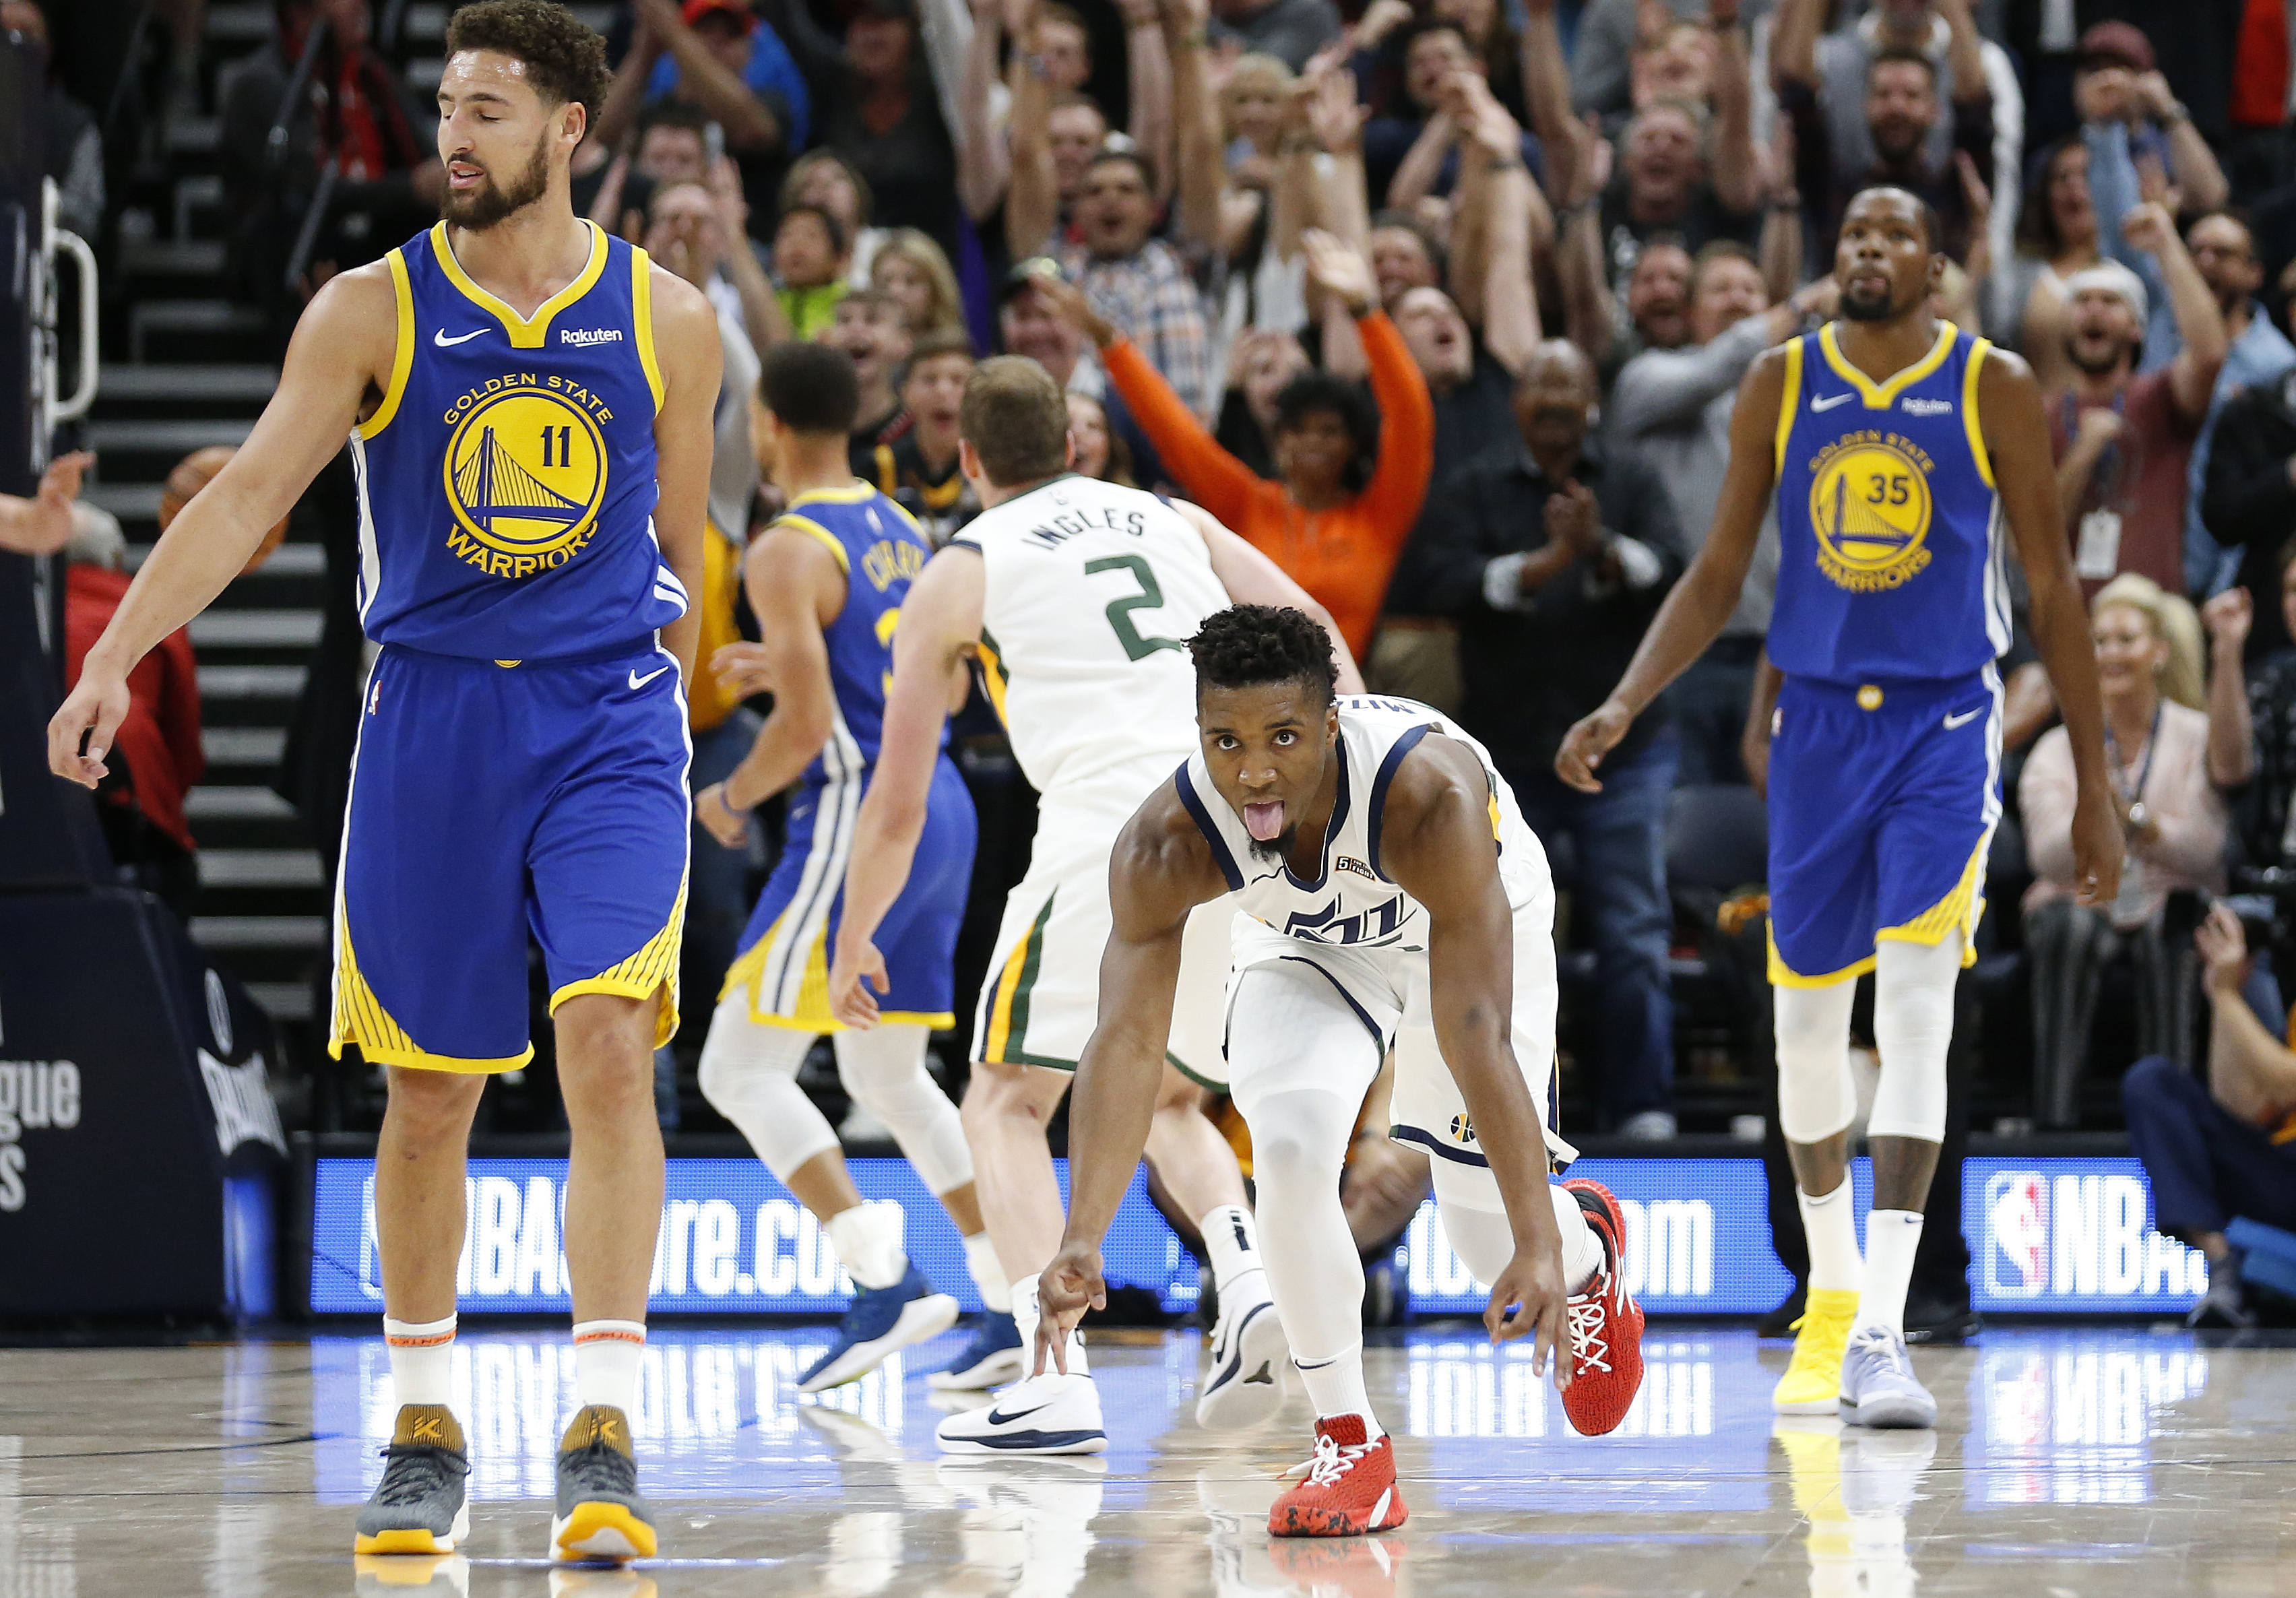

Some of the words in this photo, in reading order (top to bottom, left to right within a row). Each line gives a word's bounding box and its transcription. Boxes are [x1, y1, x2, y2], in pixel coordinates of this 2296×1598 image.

[561, 328, 623, 346] Rakuten
[443, 373, 536, 425] GOLDEN
[547, 375, 614, 425] STATE
[540, 425, 571, 468] 11
[1808, 429, 1881, 473] GOLDEN
[1886, 432, 1936, 472] STATE
[1867, 474, 1908, 505] 35
[1020, 507, 1145, 550] INGLES
[1816, 546, 1932, 594] WARRIORS
[1085, 554, 1182, 661] 2
[1338, 857, 1349, 869] 5
